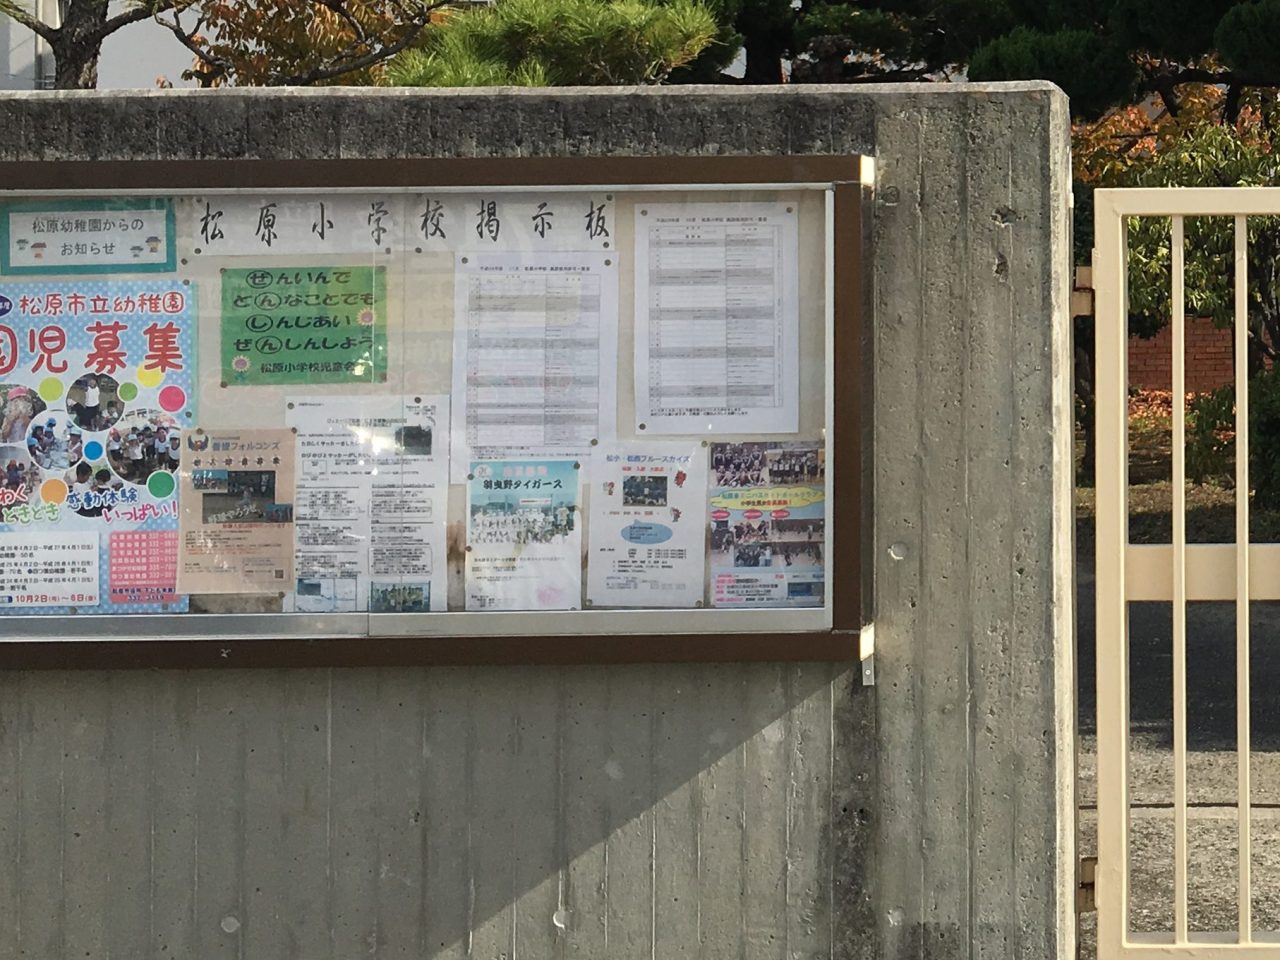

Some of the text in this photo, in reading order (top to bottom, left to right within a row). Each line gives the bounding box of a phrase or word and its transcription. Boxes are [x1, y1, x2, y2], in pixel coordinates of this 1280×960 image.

[32, 218, 144, 234] 松原幼稚園からの
[200, 199, 610, 247] 松原小学校掲示板
[60, 241, 116, 256] お知らせ
[19, 291, 185, 316] 松原市立幼稚園
[246, 314, 352, 332] しんじあい
[483, 478, 563, 490] 羽曳野タイガース
[67, 488, 138, 509] 感動体験
[3, 502, 60, 524] どきどき
